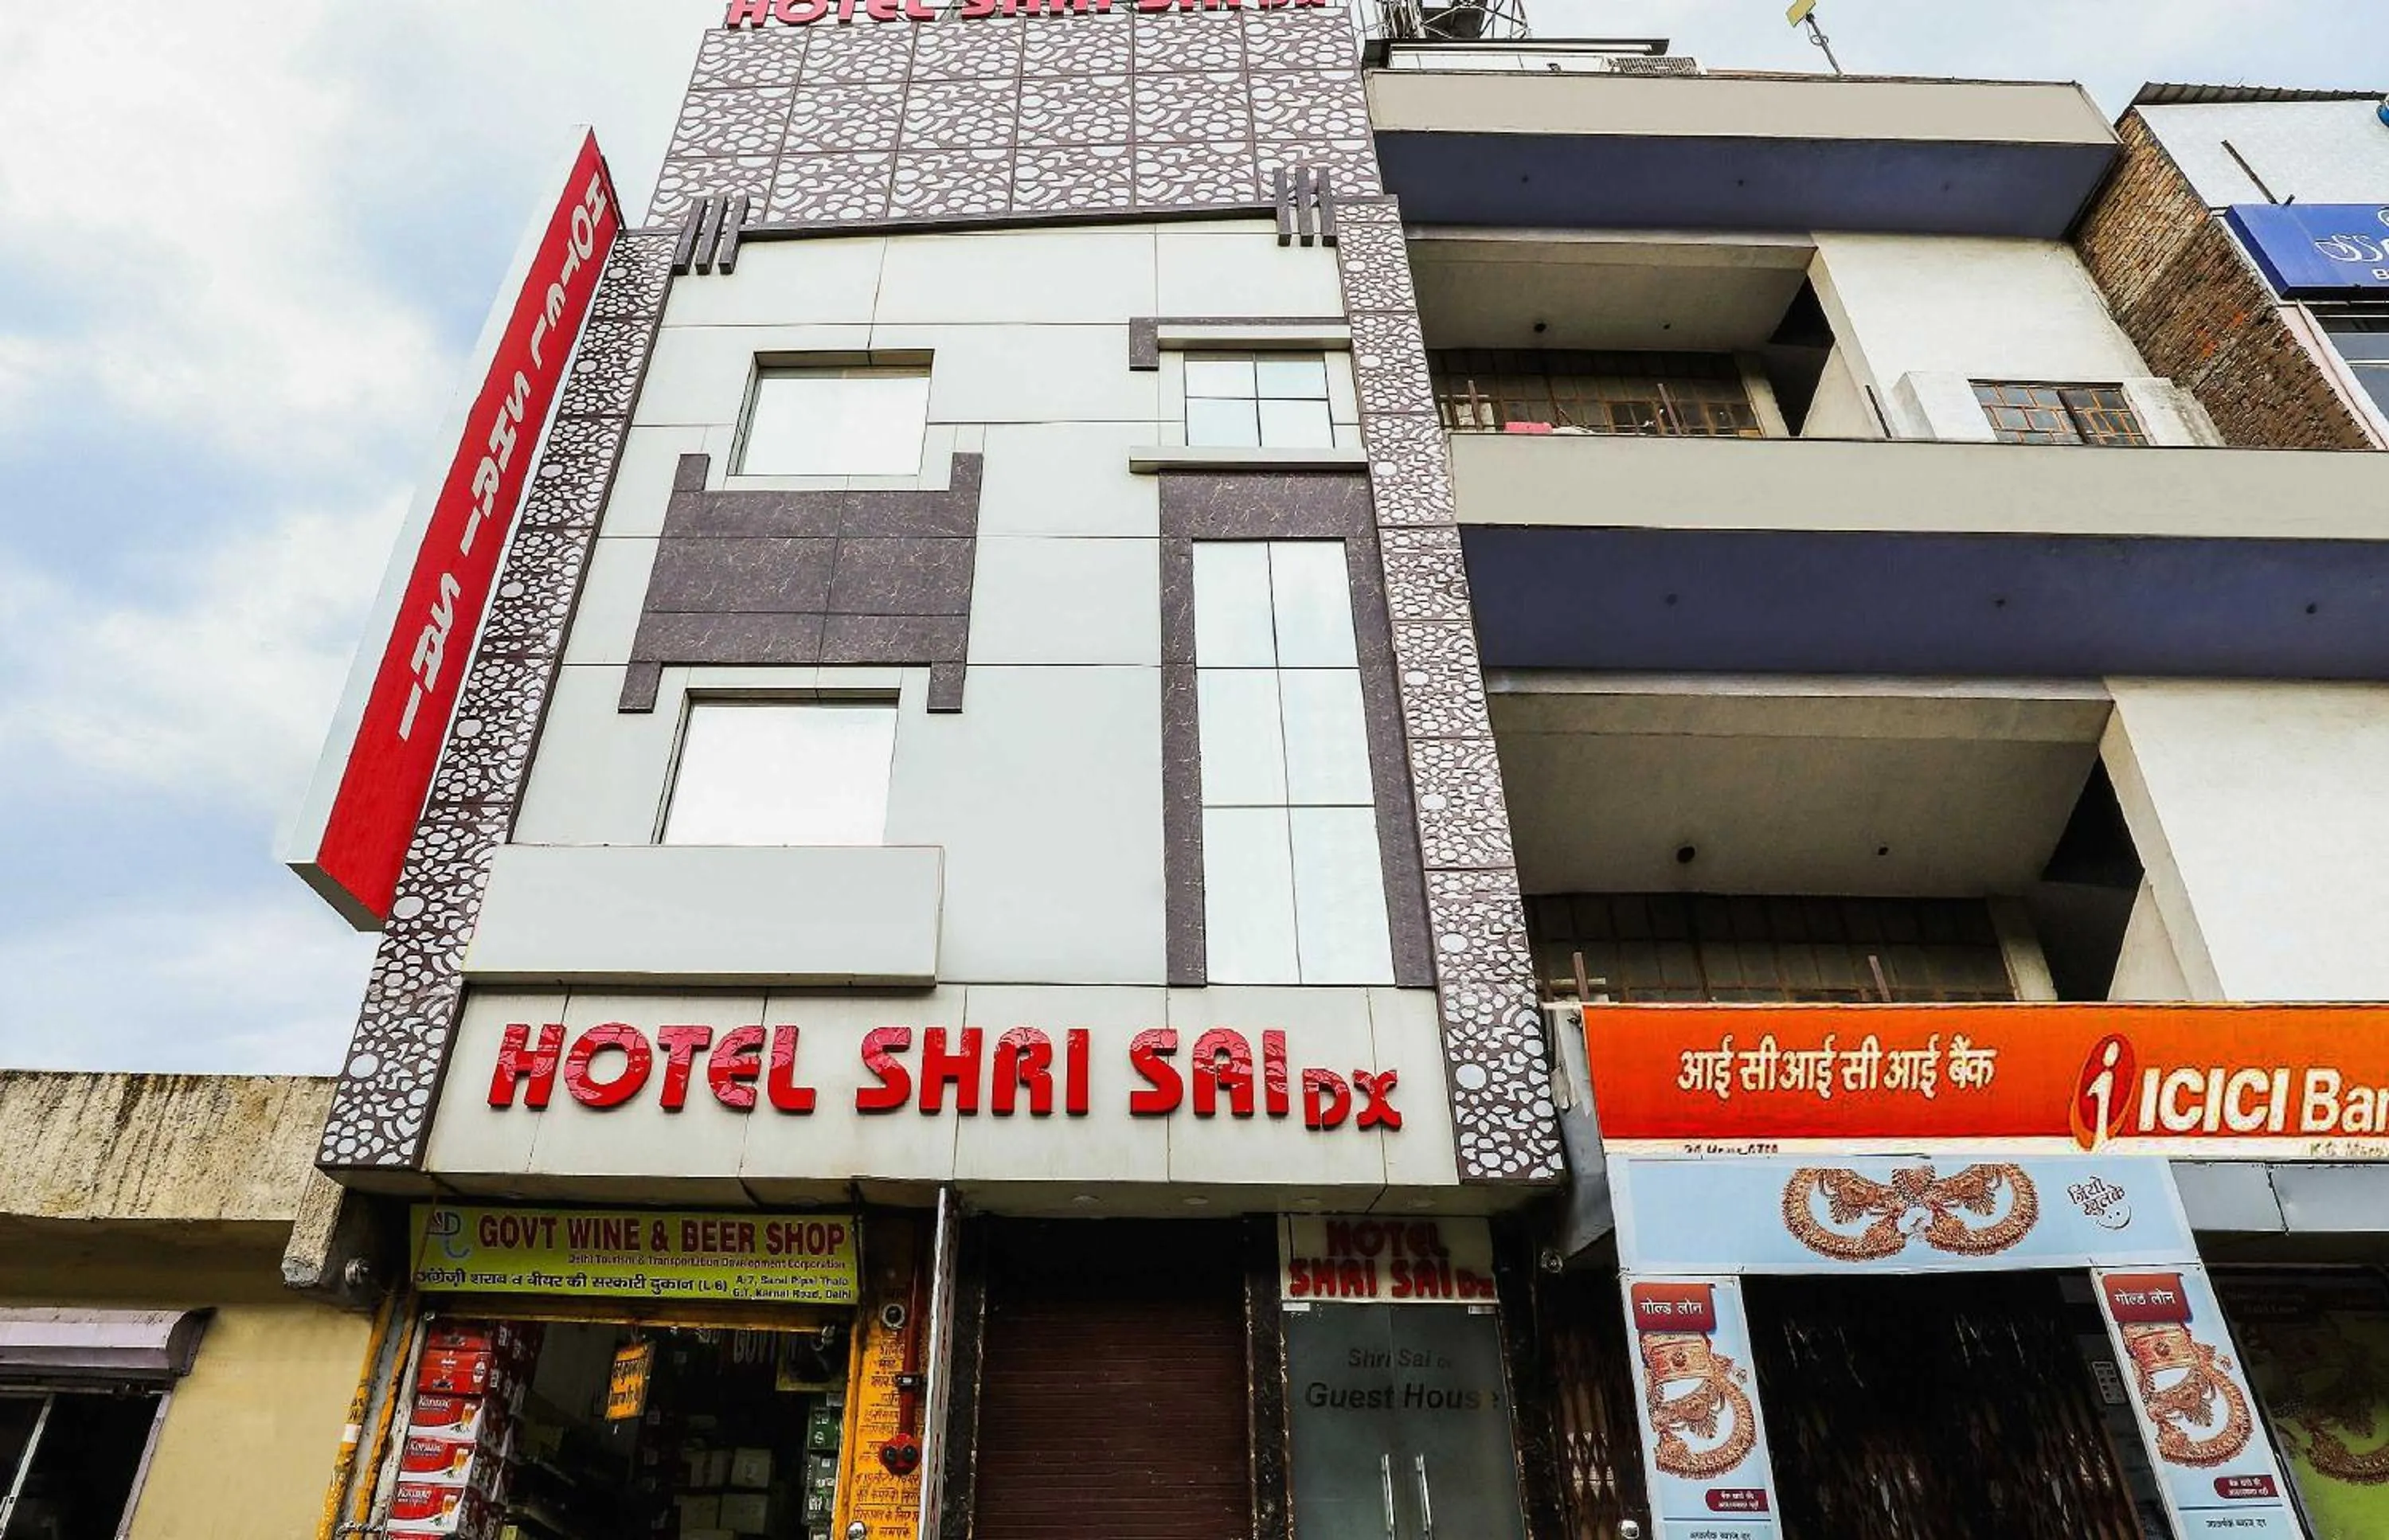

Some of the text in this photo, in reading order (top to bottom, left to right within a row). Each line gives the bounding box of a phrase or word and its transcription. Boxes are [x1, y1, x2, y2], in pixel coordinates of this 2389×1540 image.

[399, 171, 608, 741] HOTEL SHRI SAI
[487, 1022, 1402, 1130] HOTEL SHRI SAI DX
[1948, 1035, 1997, 1089] बैंक
[2138, 1066, 2292, 1132] ICICI
[479, 1214, 845, 1256] GOVT WINE & BEER SHOP
[1326, 1220, 1451, 1258] HOTEL
[1288, 1257, 1378, 1297] SHRI
[1390, 1259, 1453, 1298] SAI
[1640, 1296, 1703, 1315] गोल्ड लोन
[1347, 1348, 1391, 1369] Shri
[1398, 1348, 1432, 1368] Sai
[1305, 1382, 1394, 1409] Guest
